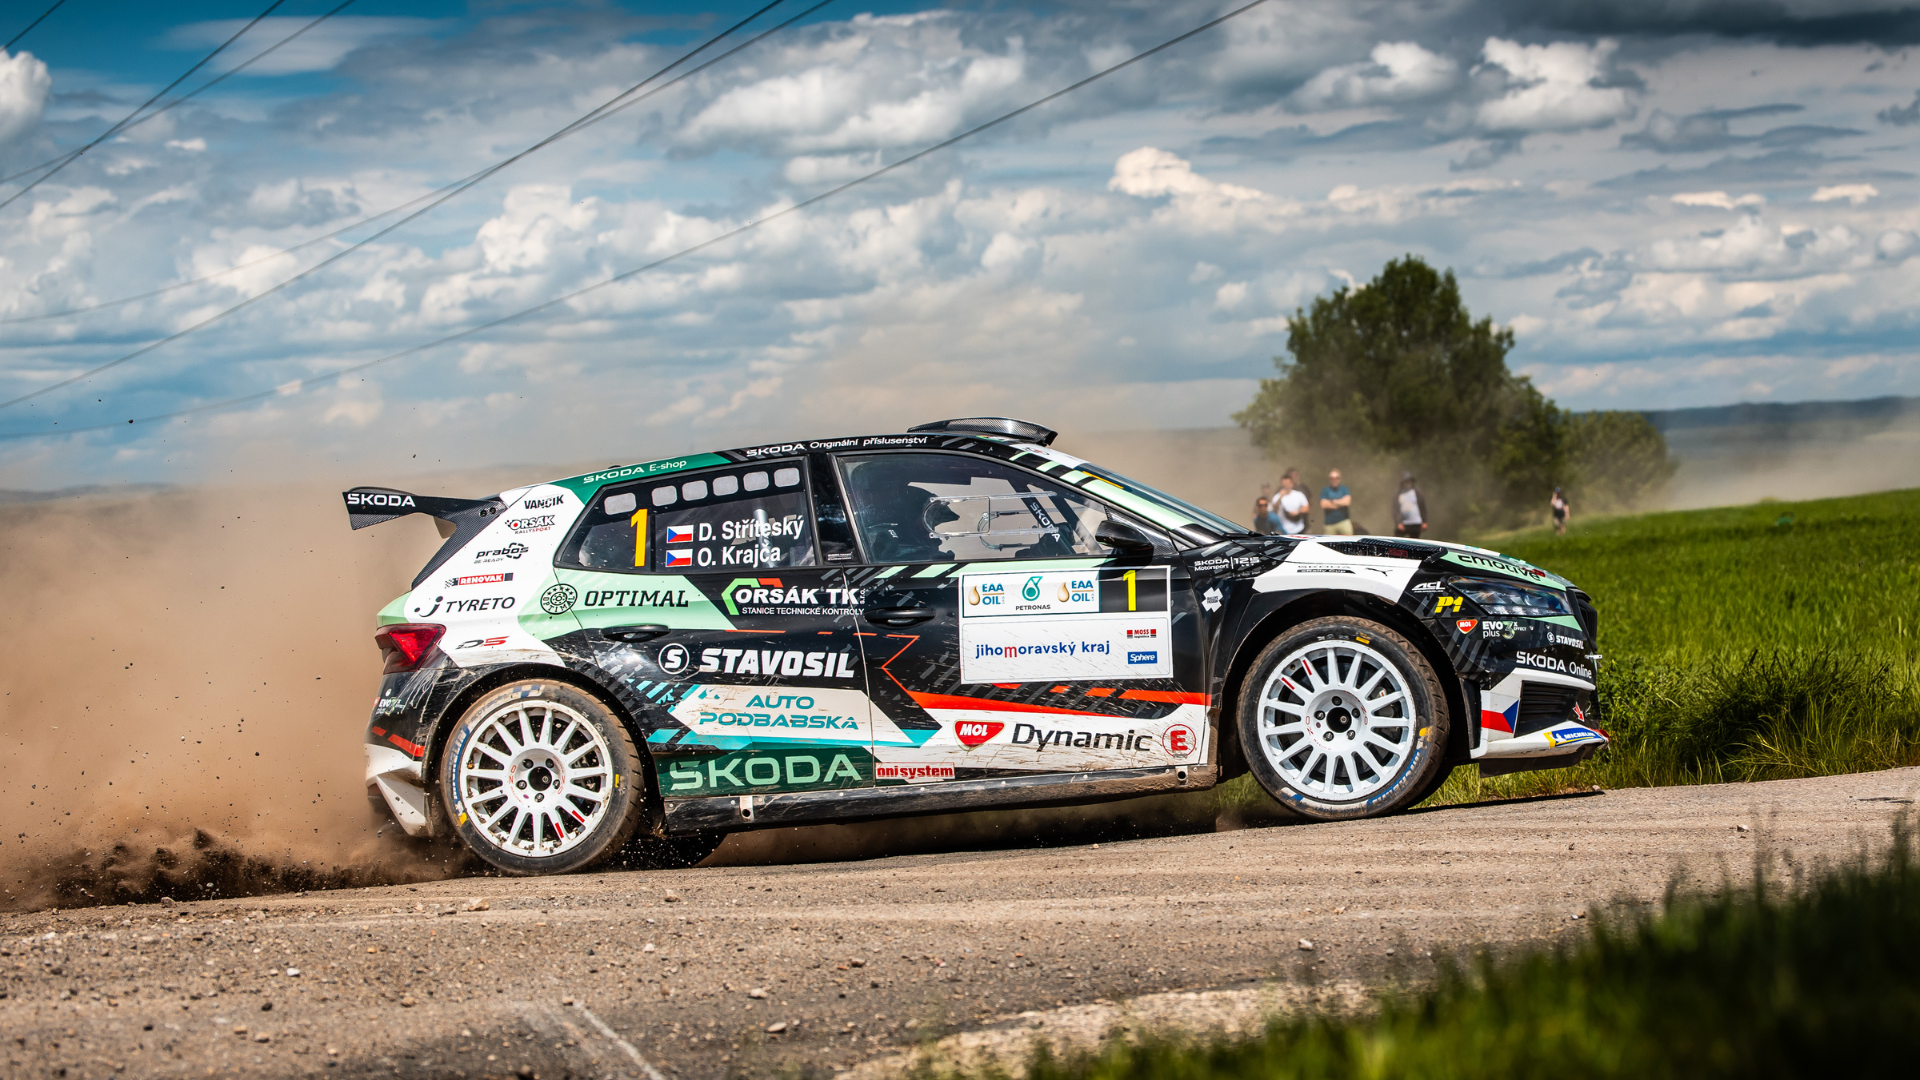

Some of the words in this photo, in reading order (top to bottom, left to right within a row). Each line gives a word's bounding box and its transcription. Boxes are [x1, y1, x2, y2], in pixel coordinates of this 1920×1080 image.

[650, 460, 686, 472] E-shop
[699, 523, 716, 541] D.
[722, 514, 804, 540] Stříteský
[630, 508, 648, 567] 1
[476, 546, 529, 559] prabos
[698, 547, 716, 567] O.
[722, 539, 780, 568] Krajča
[460, 575, 502, 584] RENOVAK
[1071, 580, 1093, 589] EAA
[1412, 581, 1446, 590] ACL
[735, 586, 819, 604] ORSÁK
[826, 588, 860, 604] TK
[982, 583, 1004, 592] EAA
[1122, 570, 1136, 611] 1
[446, 597, 515, 613] TYRETO
[584, 590, 688, 607] OPTIMAL
[982, 596, 1001, 605] OIL
[1071, 593, 1090, 602] OIL
[1434, 596, 1464, 613] P1
[776, 606, 820, 615] TECHNICKÉ
[1482, 621, 1503, 630] EVO
[1502, 621, 1515, 639] 3
[1483, 629, 1500, 639] plus
[976, 642, 1076, 659] jihomoravský
[1082, 641, 1110, 655] kraj
[1556, 635, 1584, 650] STAVOSIL
[700, 648, 854, 678] STAVOSIL
[1130, 654, 1155, 663] Sphere
[1569, 661, 1592, 679] Online
[746, 694, 815, 709] AUTO
[959, 724, 988, 736] MOL
[1011, 723, 1152, 752] Dynamic
